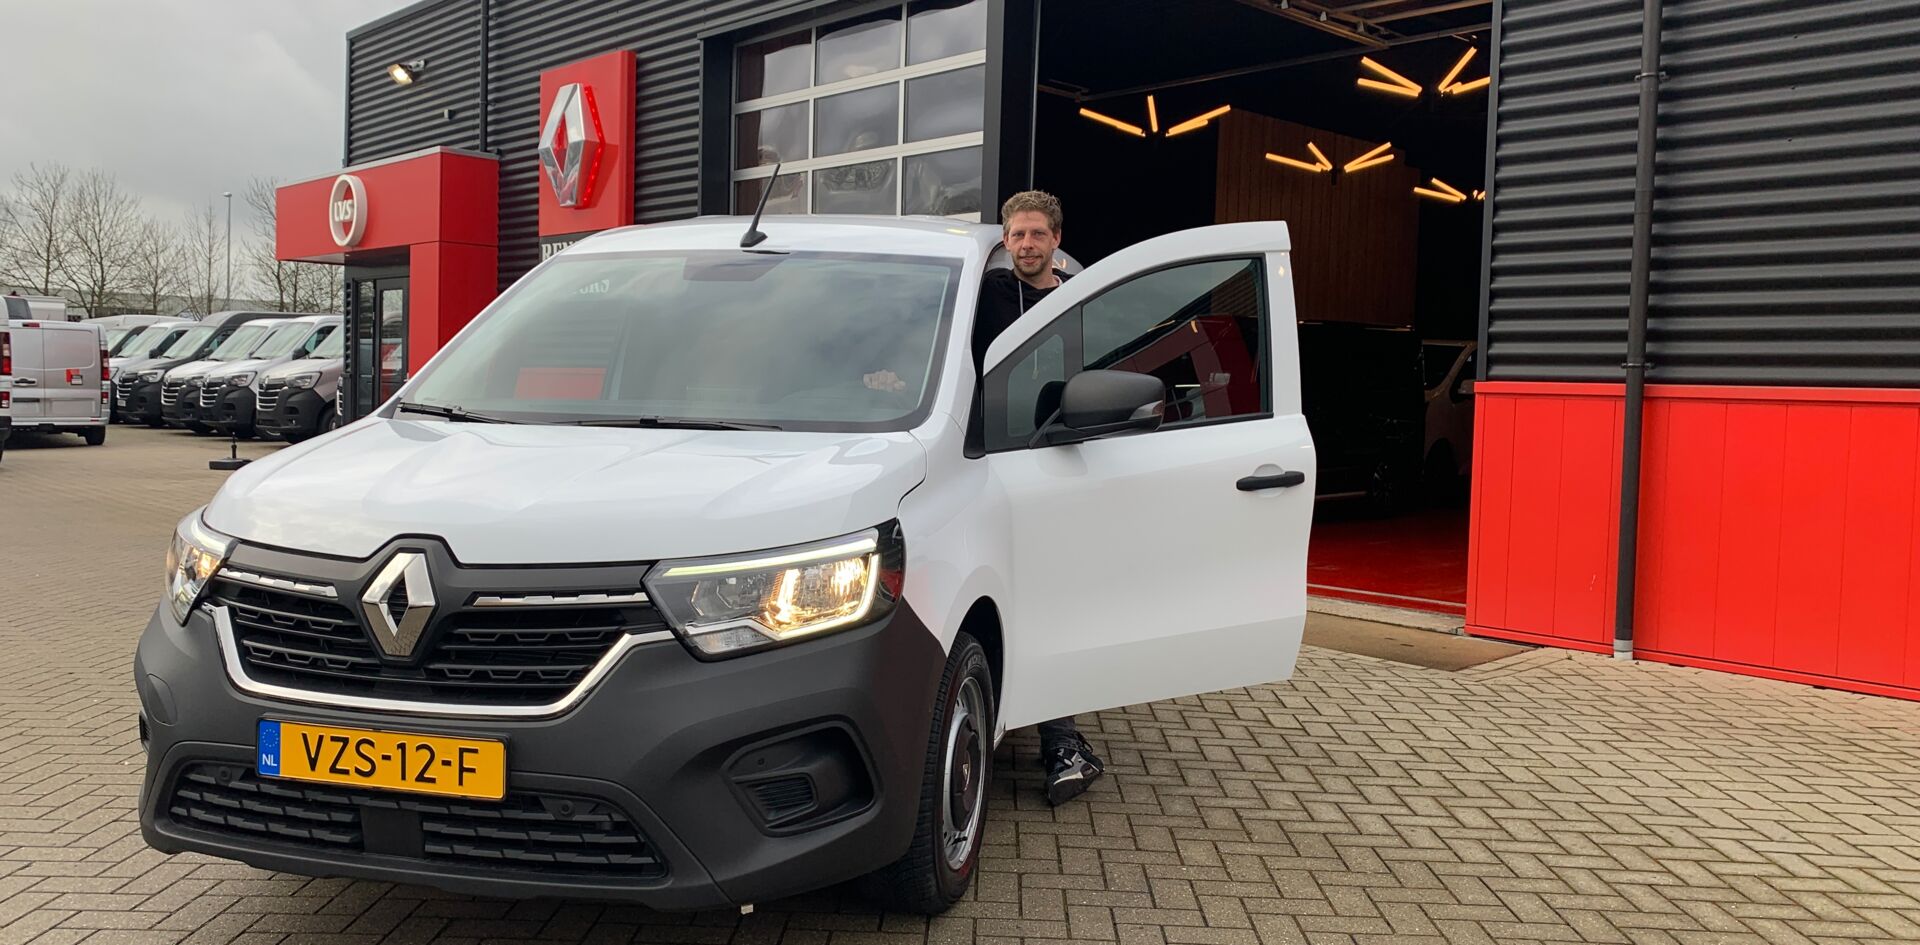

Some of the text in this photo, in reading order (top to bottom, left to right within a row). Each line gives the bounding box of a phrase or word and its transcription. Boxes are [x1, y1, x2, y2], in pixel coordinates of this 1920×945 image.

[334, 199, 354, 222] LVS
[262, 753, 277, 767] NL
[301, 732, 479, 786] VZS-12-F
